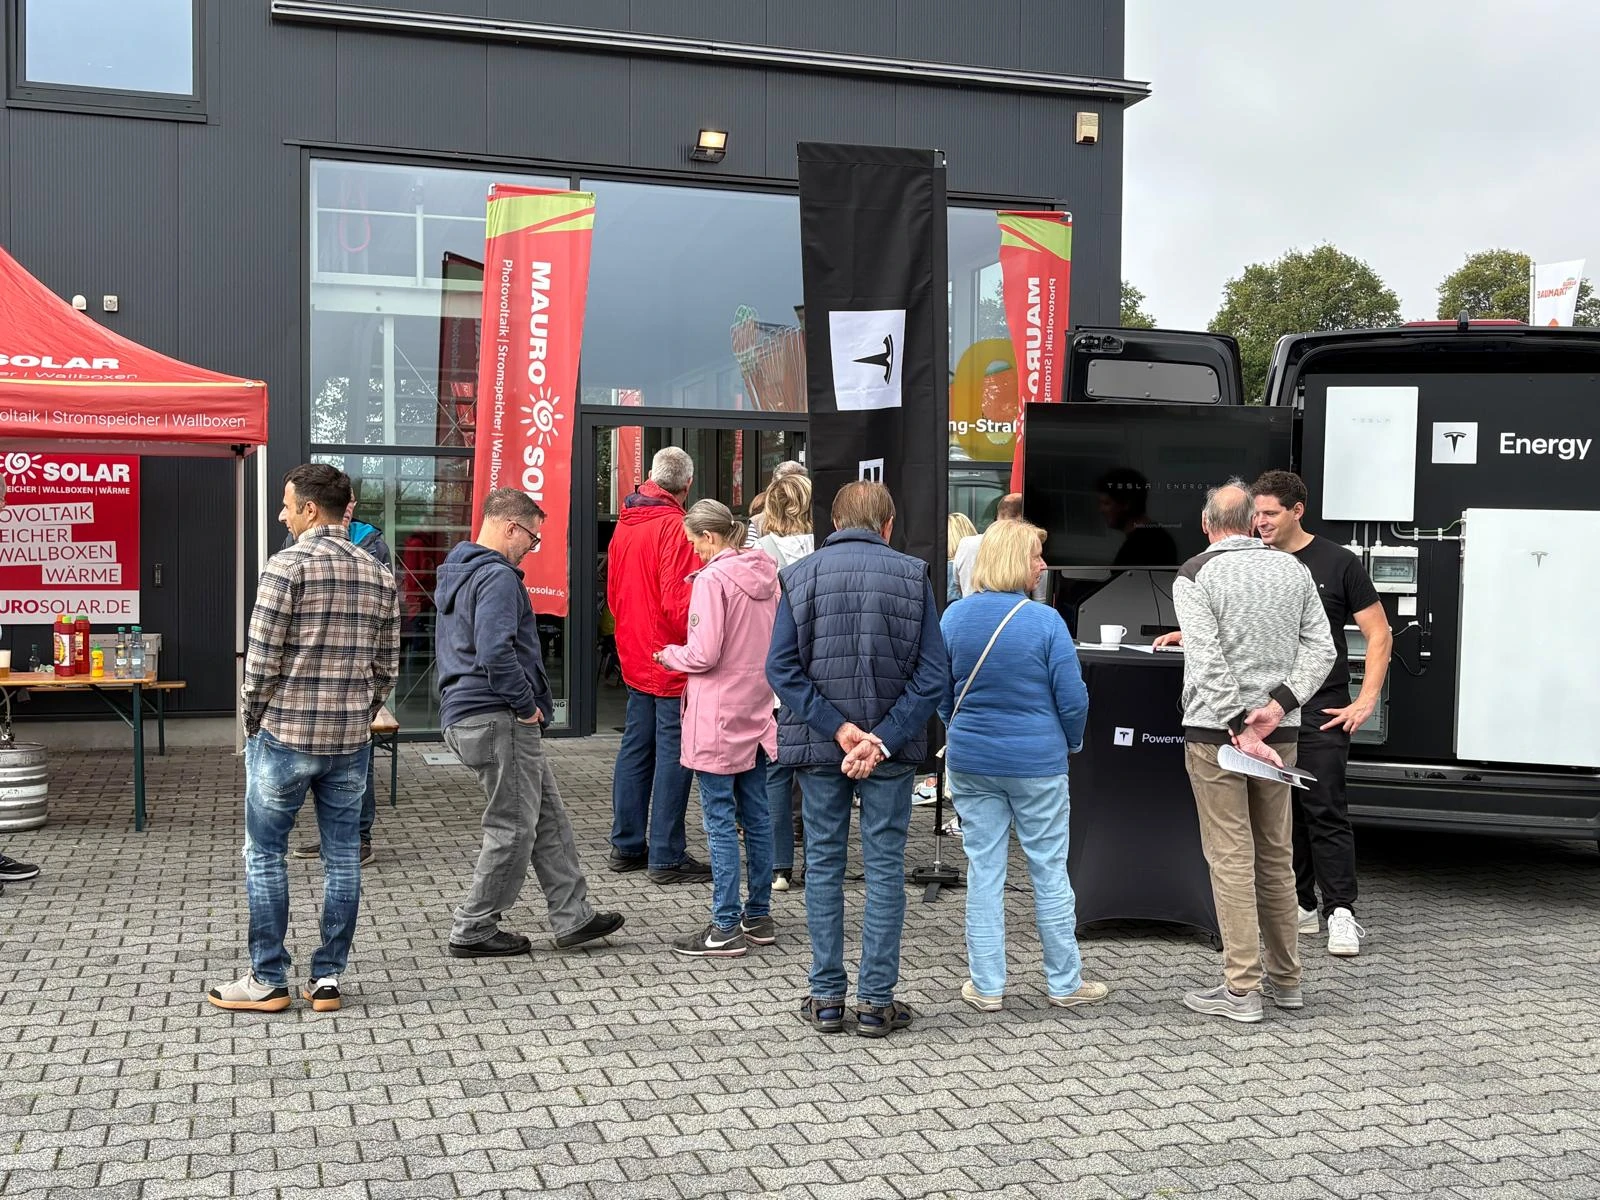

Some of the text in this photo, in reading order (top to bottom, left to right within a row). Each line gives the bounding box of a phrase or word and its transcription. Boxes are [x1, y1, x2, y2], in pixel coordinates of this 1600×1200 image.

[499, 259, 513, 336] Photovoltaik
[528, 261, 551, 385] MAURO
[35, 372, 138, 380] Wallboxen
[494, 345, 508, 431] Stromspeicher
[0, 408, 246, 428] oltaik Stromspeicher Wallboxen
[1500, 432, 1592, 460] Energy
[43, 462, 131, 483] SOLAR
[42, 486, 94, 494] WALLBOXEN
[99, 486, 131, 495] WÄRME
[0, 505, 92, 522] OVOLTAIK
[0, 528, 68, 543] EICHER
[0, 545, 113, 562] WALLBOXEN
[45, 565, 119, 583] WÄRME
[0, 599, 131, 614] UROSOLAR.DE
[1142, 733, 1185, 743] Powerw
